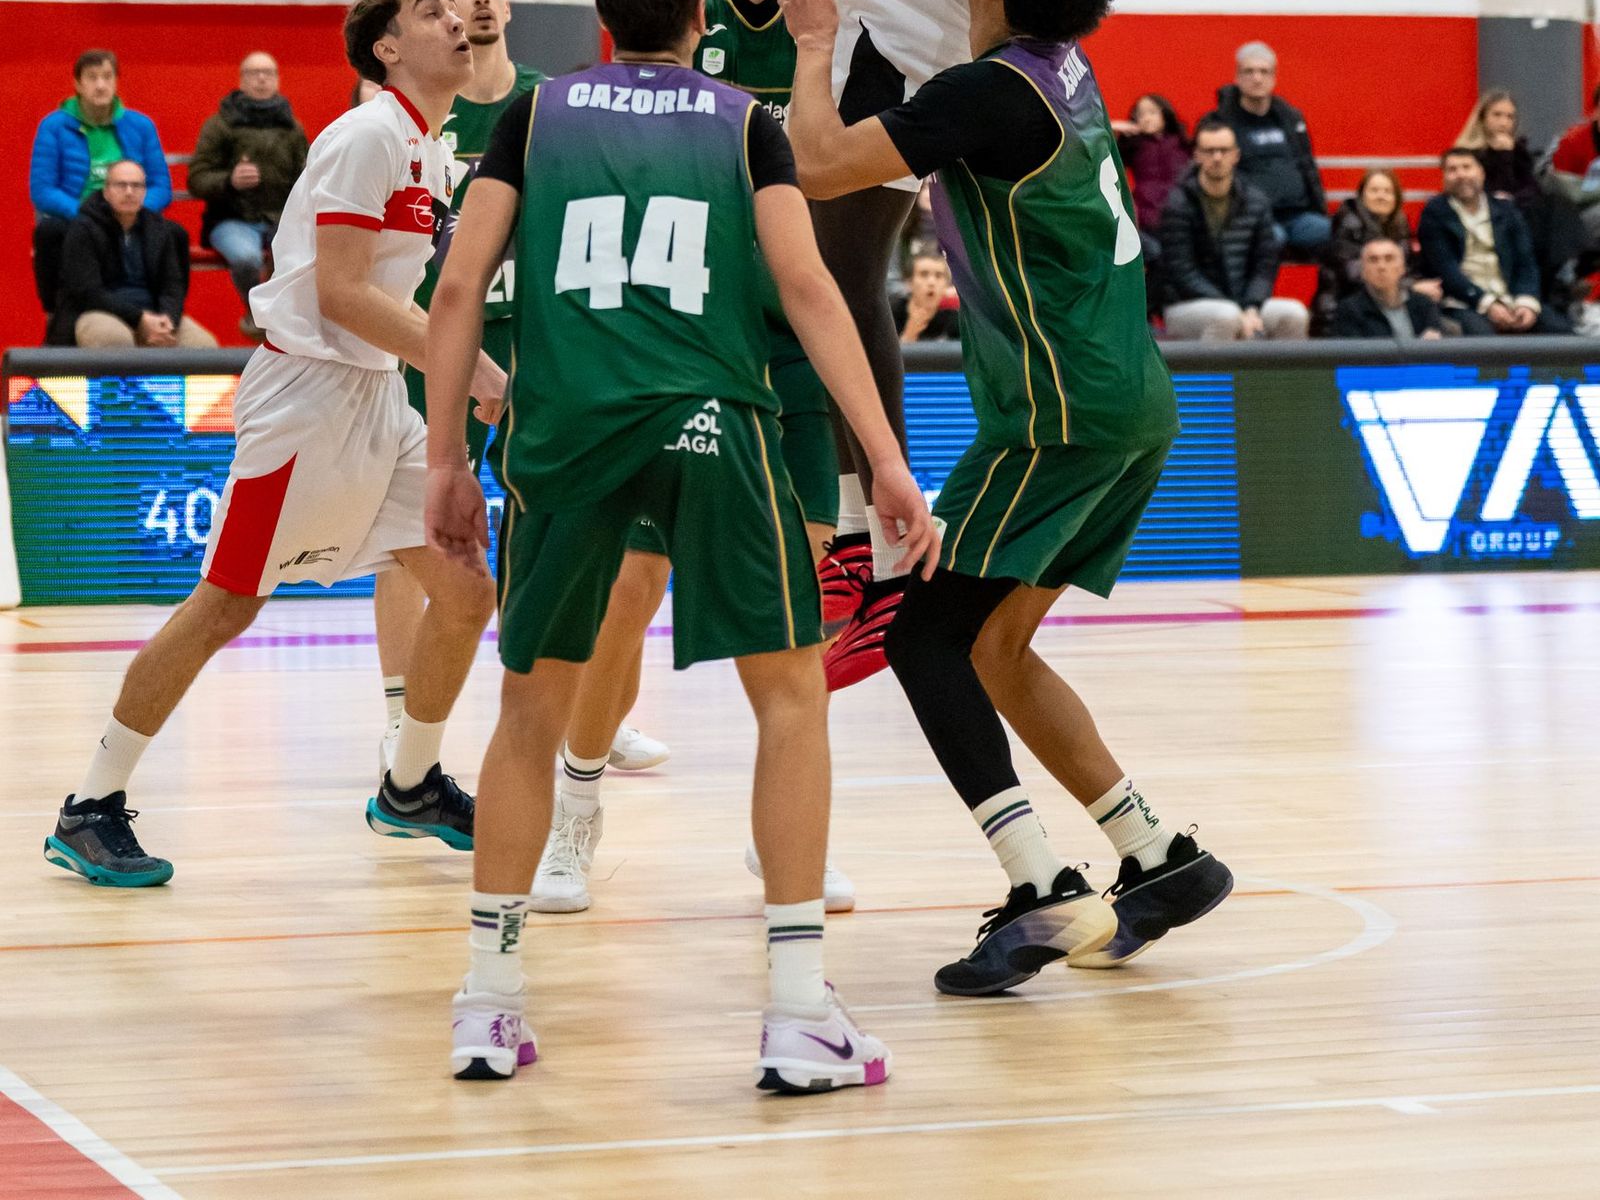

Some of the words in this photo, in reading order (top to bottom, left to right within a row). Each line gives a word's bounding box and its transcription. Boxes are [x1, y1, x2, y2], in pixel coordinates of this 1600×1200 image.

[567, 82, 716, 115] CAZORLA
[554, 195, 711, 316] 44
[1470, 530, 1561, 553] GROUP
